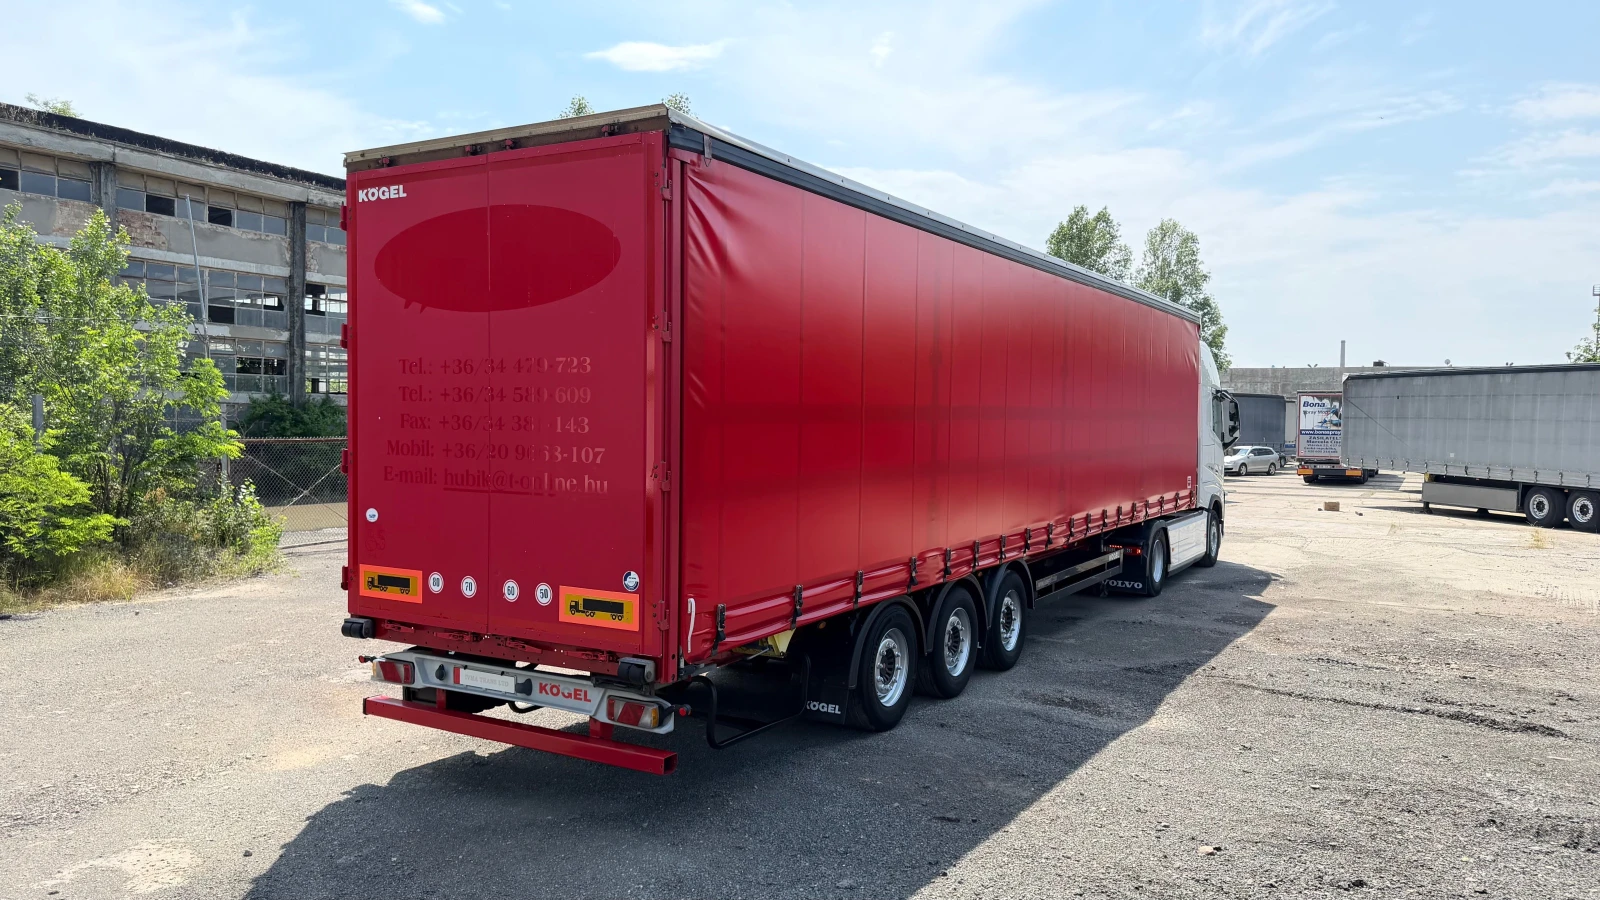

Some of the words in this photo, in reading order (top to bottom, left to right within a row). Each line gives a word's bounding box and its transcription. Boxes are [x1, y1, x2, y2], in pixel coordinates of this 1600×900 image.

[358, 184, 407, 202] KÖGEL
[398, 358, 433, 375] Tel.:
[440, 357, 506, 376] +36/34
[512, 356, 592, 375] 479-723
[398, 385, 433, 402] Tel.:
[440, 385, 507, 404] +36/34
[400, 413, 431, 430] Fax:
[438, 414, 505, 432] +36/34
[386, 439, 435, 458] Mobil:
[441, 442, 509, 461] +36/20
[383, 465, 437, 485] E-mail:
[432, 577, 440, 587] 80
[464, 581, 473, 591] 70
[507, 585, 515, 596] 60
[539, 588, 549, 599] 50
[538, 682, 592, 703] KÖGEL
